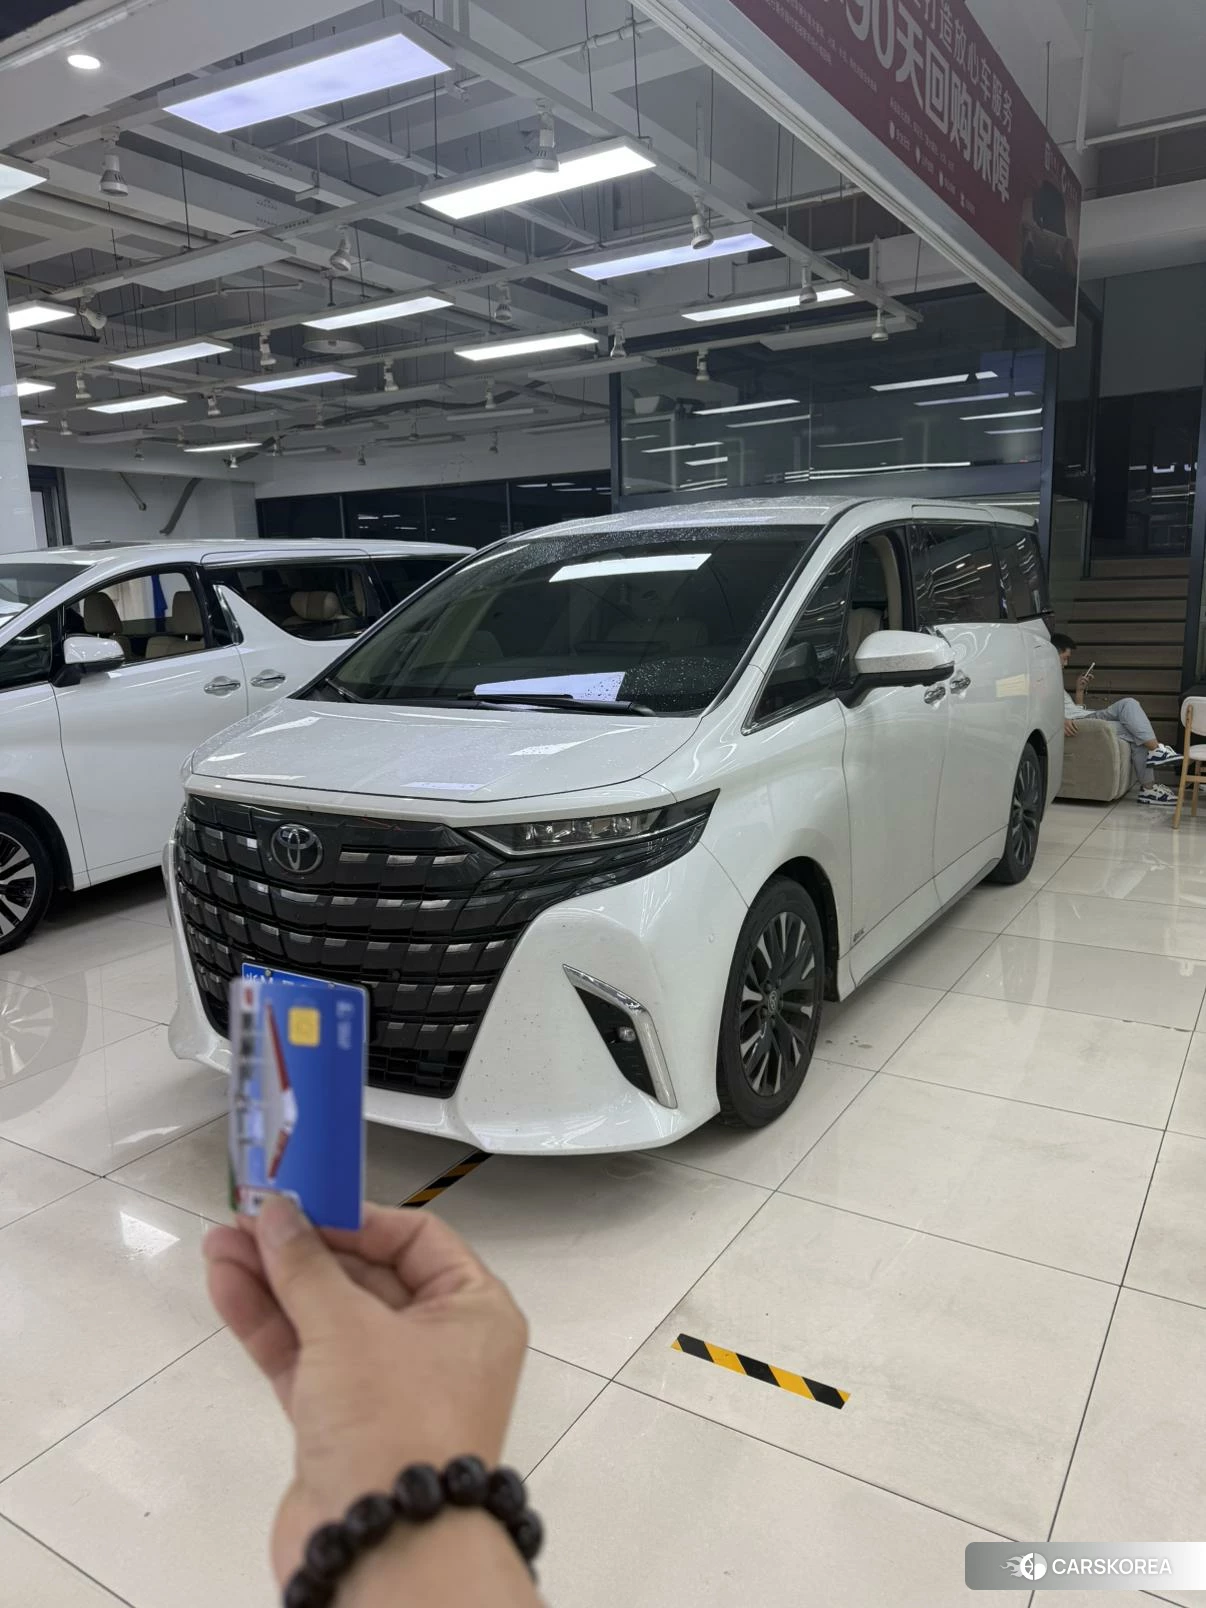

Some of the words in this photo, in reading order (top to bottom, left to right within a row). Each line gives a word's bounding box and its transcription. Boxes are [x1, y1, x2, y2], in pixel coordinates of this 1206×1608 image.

[914, 0, 1012, 132] 打造放心车服务
